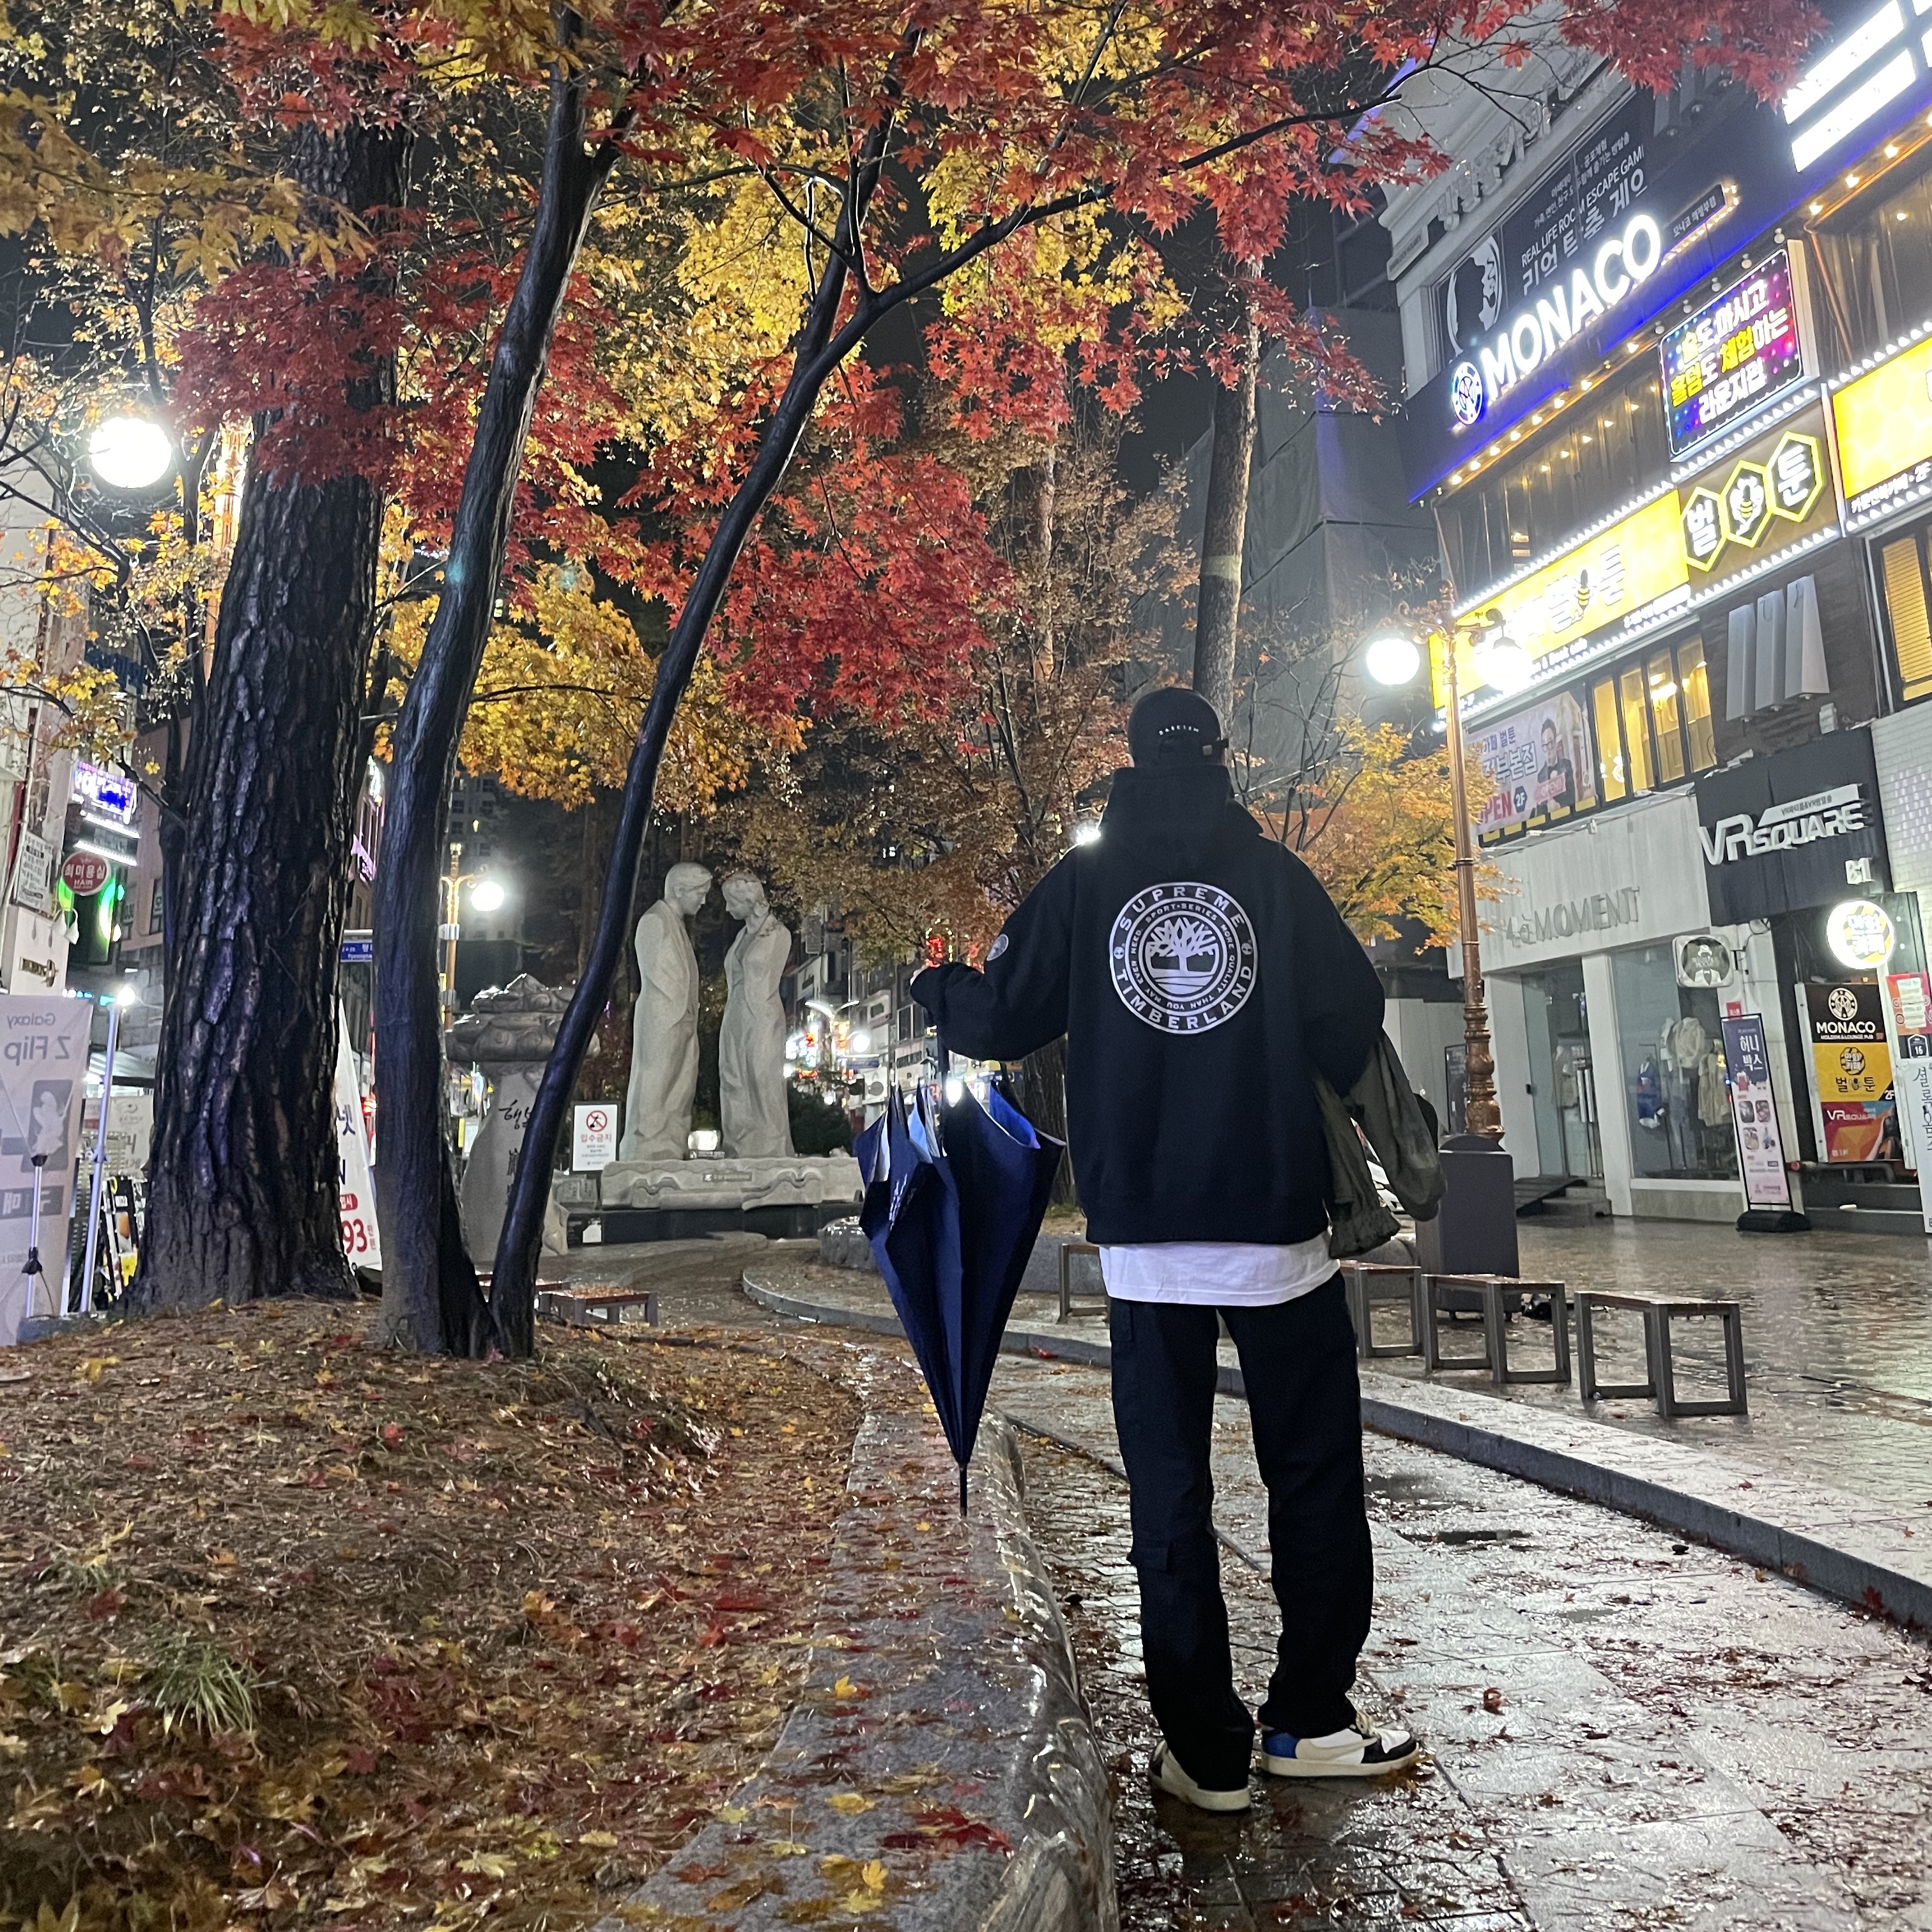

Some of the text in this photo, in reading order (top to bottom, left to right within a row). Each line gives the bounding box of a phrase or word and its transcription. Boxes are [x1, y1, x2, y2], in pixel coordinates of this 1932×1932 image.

[1522, 241, 1541, 268] REAL
[1542, 225, 1558, 249] LIFE
[1587, 167, 1620, 208] ESCAPE
[1621, 144, 1644, 175] GAM
[1481, 215, 1661, 400] MONACO
[1719, 308, 1788, 372] 체험하는
[1480, 791, 1512, 824] PEN
[1516, 792, 1526, 808] 2F
[1119, 886, 1245, 931] SUPREME
[1220, 924, 1234, 949] MORE
[1131, 961, 1144, 985] EVER
[1218, 954, 1235, 993] QUALITY
[1117, 965, 1252, 1029] TIMBERLAND
[1167, 1002, 1184, 1010] YOU
[1190, 995, 1215, 1009] THAN
[1816, 1021, 1876, 1034] MONACO
[1740, 1034, 1759, 1052] 허니
[1915, 1045, 1923, 1055] 16
[580, 1133, 612, 1143] 입수금지
